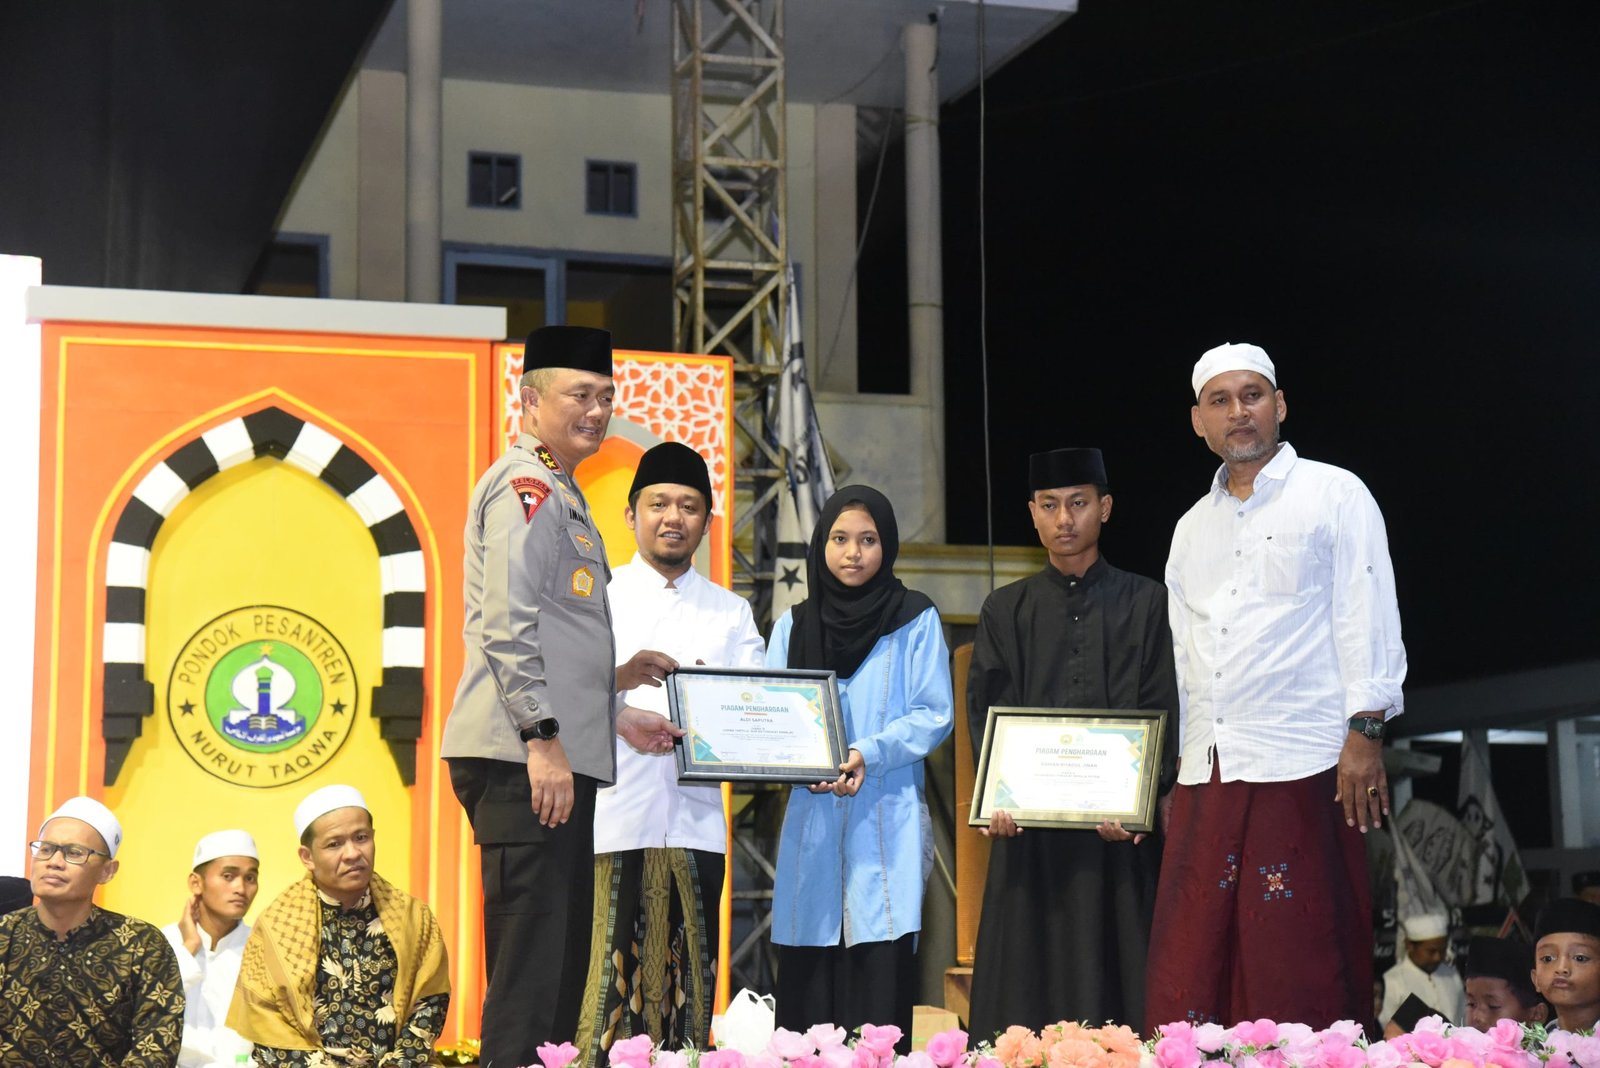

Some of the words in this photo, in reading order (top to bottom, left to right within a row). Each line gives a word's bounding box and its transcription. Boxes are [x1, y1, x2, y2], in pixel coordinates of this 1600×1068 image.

[178, 623, 241, 685] PONDOK
[253, 614, 348, 685] PESANTREN
[191, 730, 257, 777] NURUT
[269, 729, 338, 779] TAQWA
